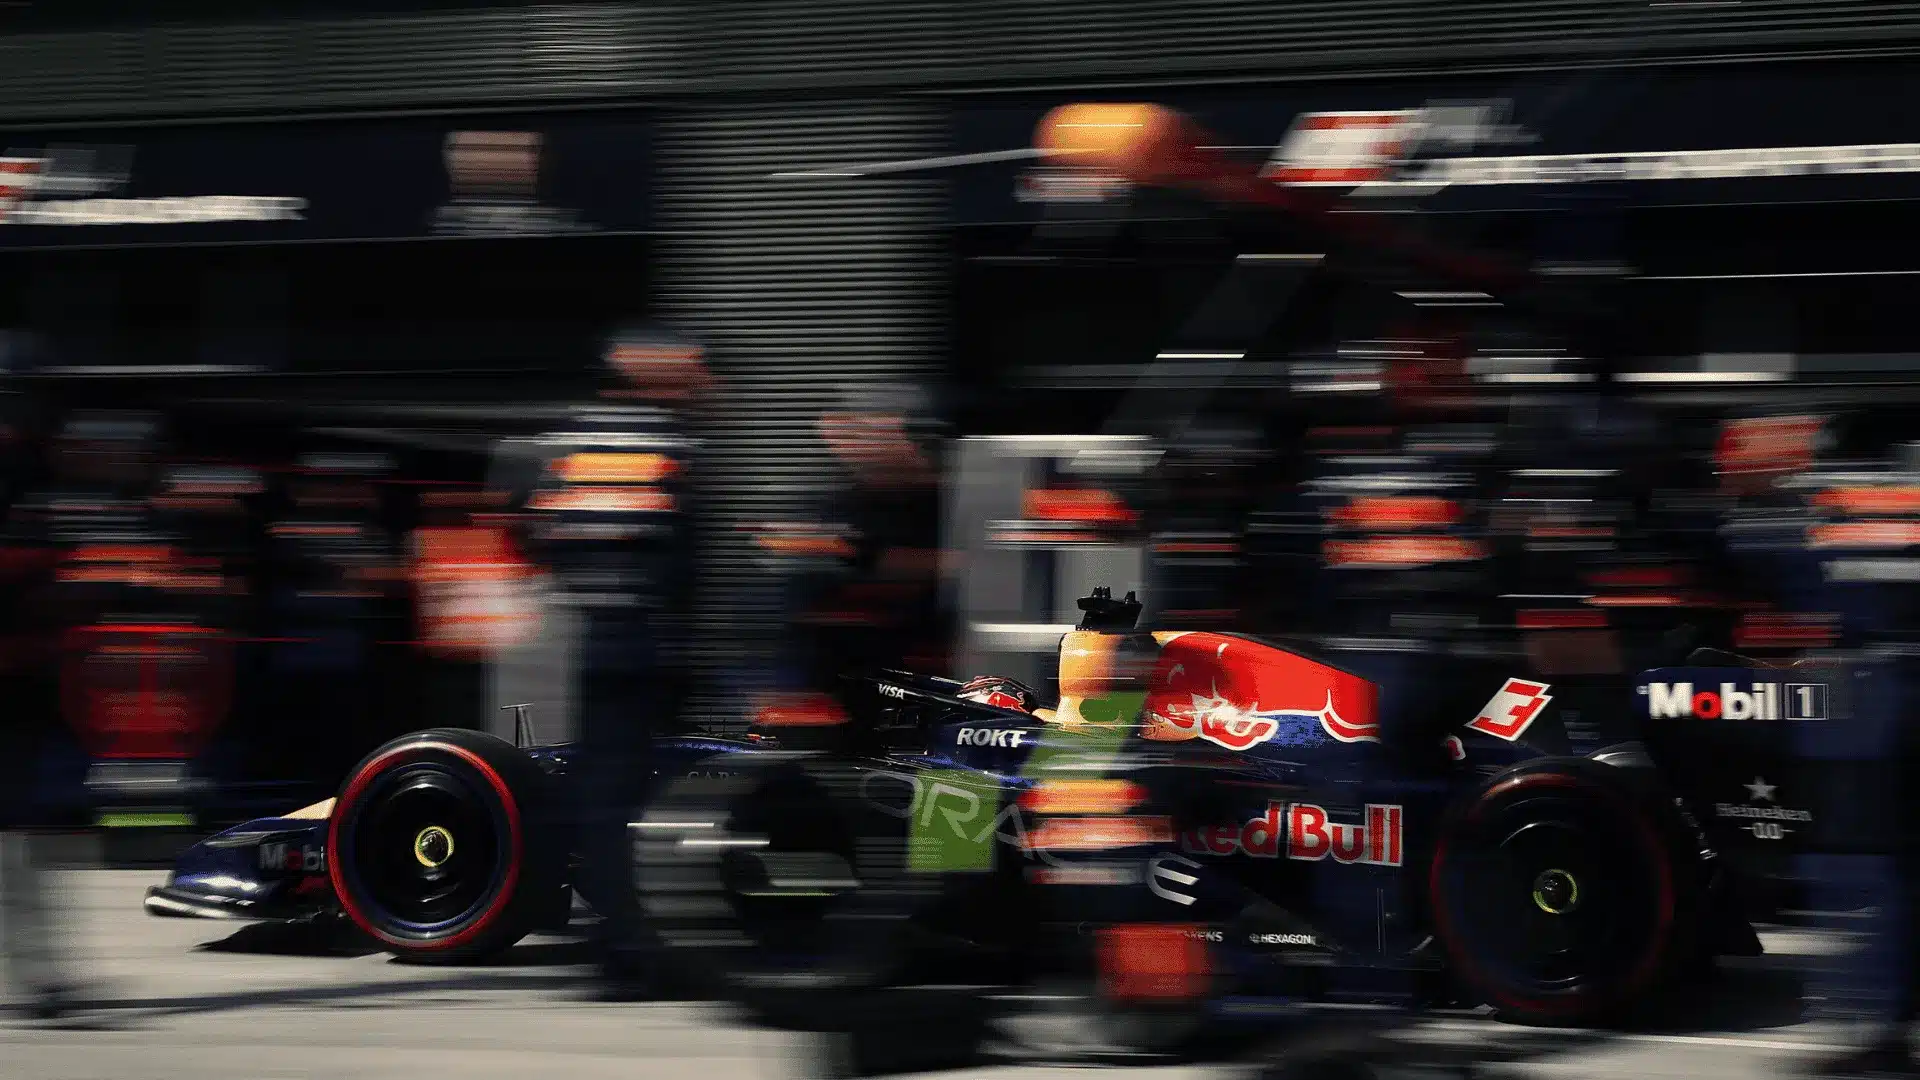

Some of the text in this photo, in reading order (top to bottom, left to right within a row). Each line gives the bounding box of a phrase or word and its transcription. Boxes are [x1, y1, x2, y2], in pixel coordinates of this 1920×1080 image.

[877, 683, 905, 700] VISA
[1648, 682, 1782, 720] Mobil
[956, 727, 1028, 748] ROKT
[1286, 802, 1403, 867] Bull
[1260, 933, 1312, 944] HEXAGON
